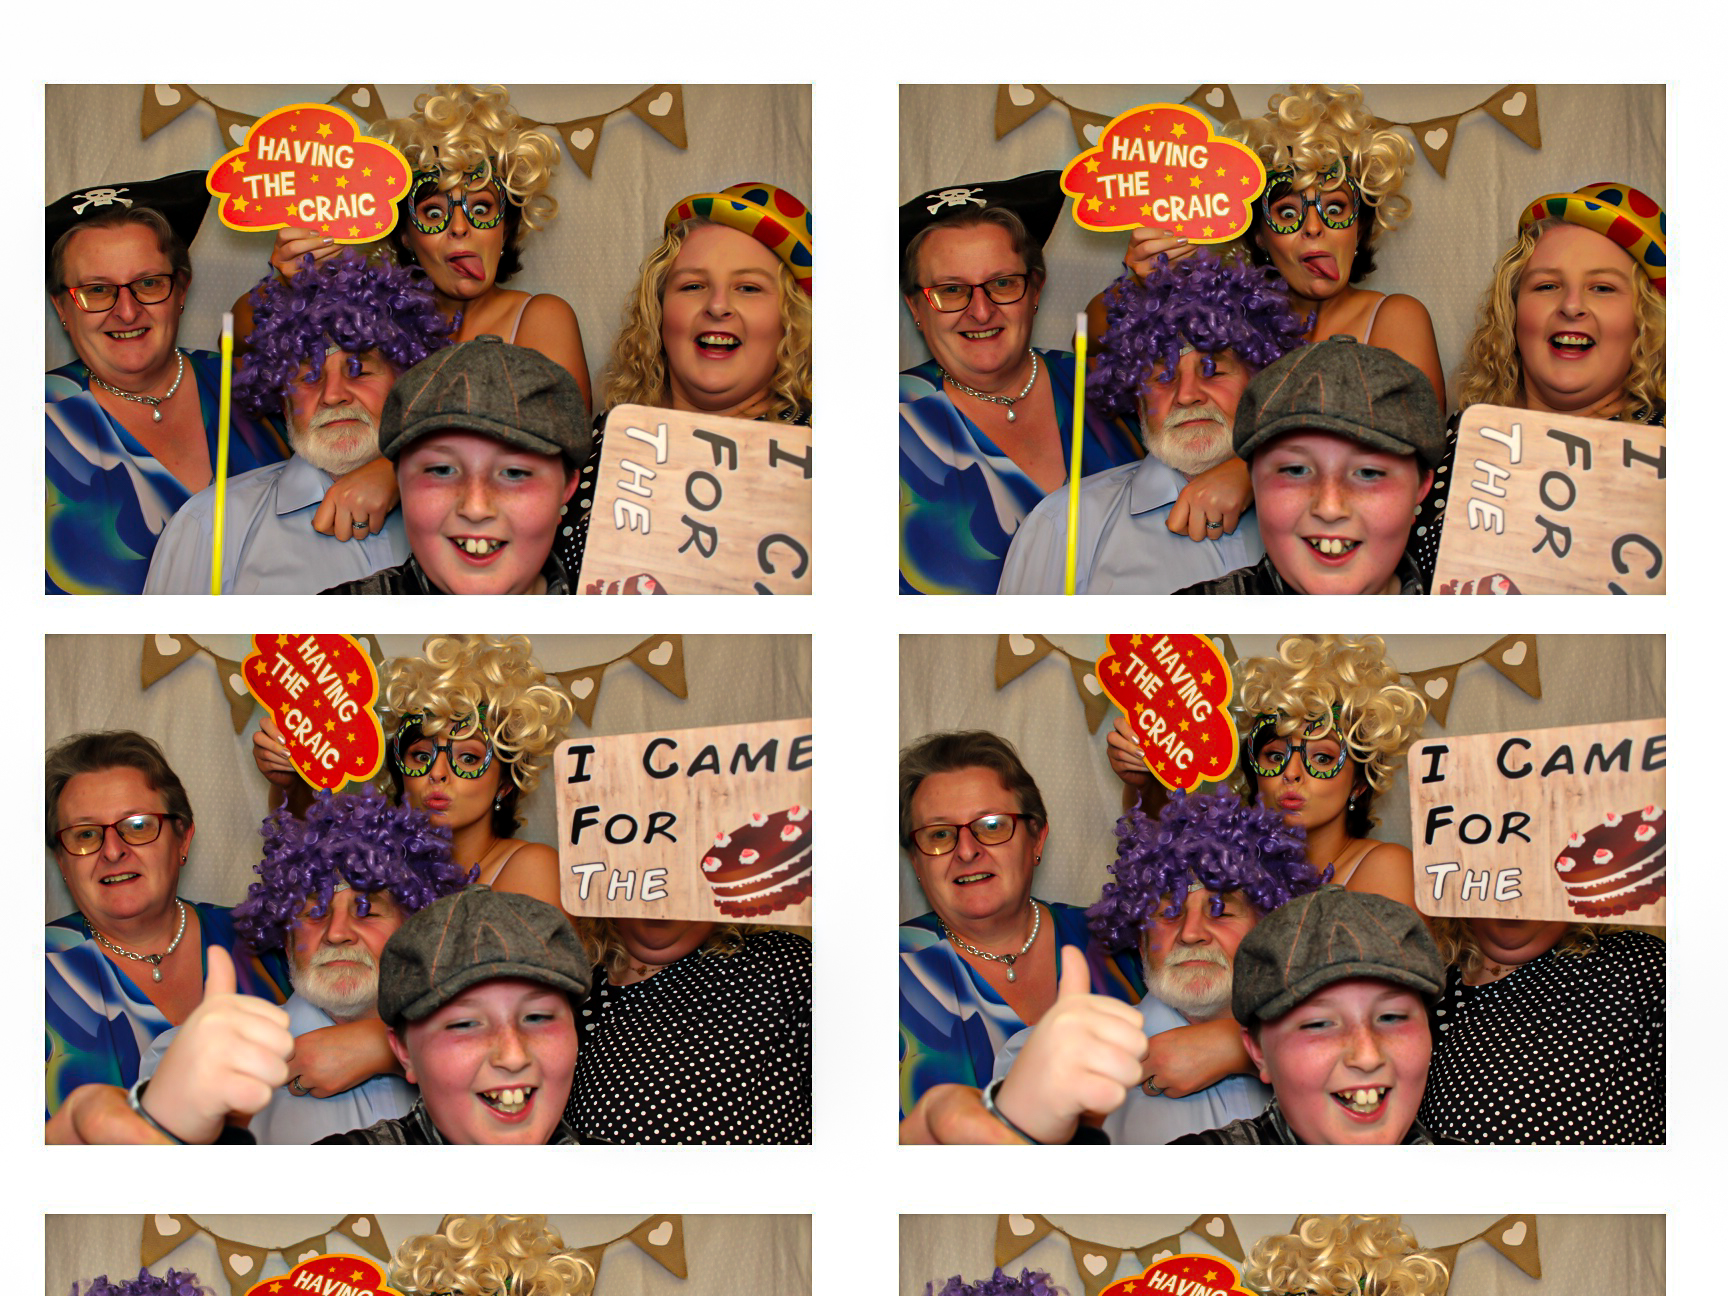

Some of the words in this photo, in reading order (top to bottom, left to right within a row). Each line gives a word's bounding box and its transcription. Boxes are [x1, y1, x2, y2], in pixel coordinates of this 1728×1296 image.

[257, 135, 355, 169] HAVING
[1111, 135, 1209, 169] HAVING
[242, 171, 296, 199] THE
[1096, 171, 1150, 199] THE
[298, 193, 376, 222] CRAIC
[1152, 193, 1230, 222] CRAIC
[613, 423, 668, 535] THE
[769, 439, 812, 479] I
[1467, 423, 1522, 535] THE
[1623, 439, 1666, 479] I
[678, 428, 738, 558] FOR
[1532, 428, 1592, 558] FOR
[271, 652, 310, 700] THE
[297, 635, 358, 722] HAVING
[1125, 652, 1164, 700] THE
[1151, 635, 1212, 722] HAVING
[284, 709, 340, 770] CRAIC
[567, 744, 595, 784] I
[642, 734, 812, 779] CAME
[1138, 709, 1194, 770] CRAIC
[1421, 744, 1449, 784] I
[1496, 734, 1666, 779] CAME
[570, 805, 677, 845] FOR
[1424, 805, 1531, 845] FOR
[571, 862, 669, 901] THE
[1425, 862, 1523, 901] THE
